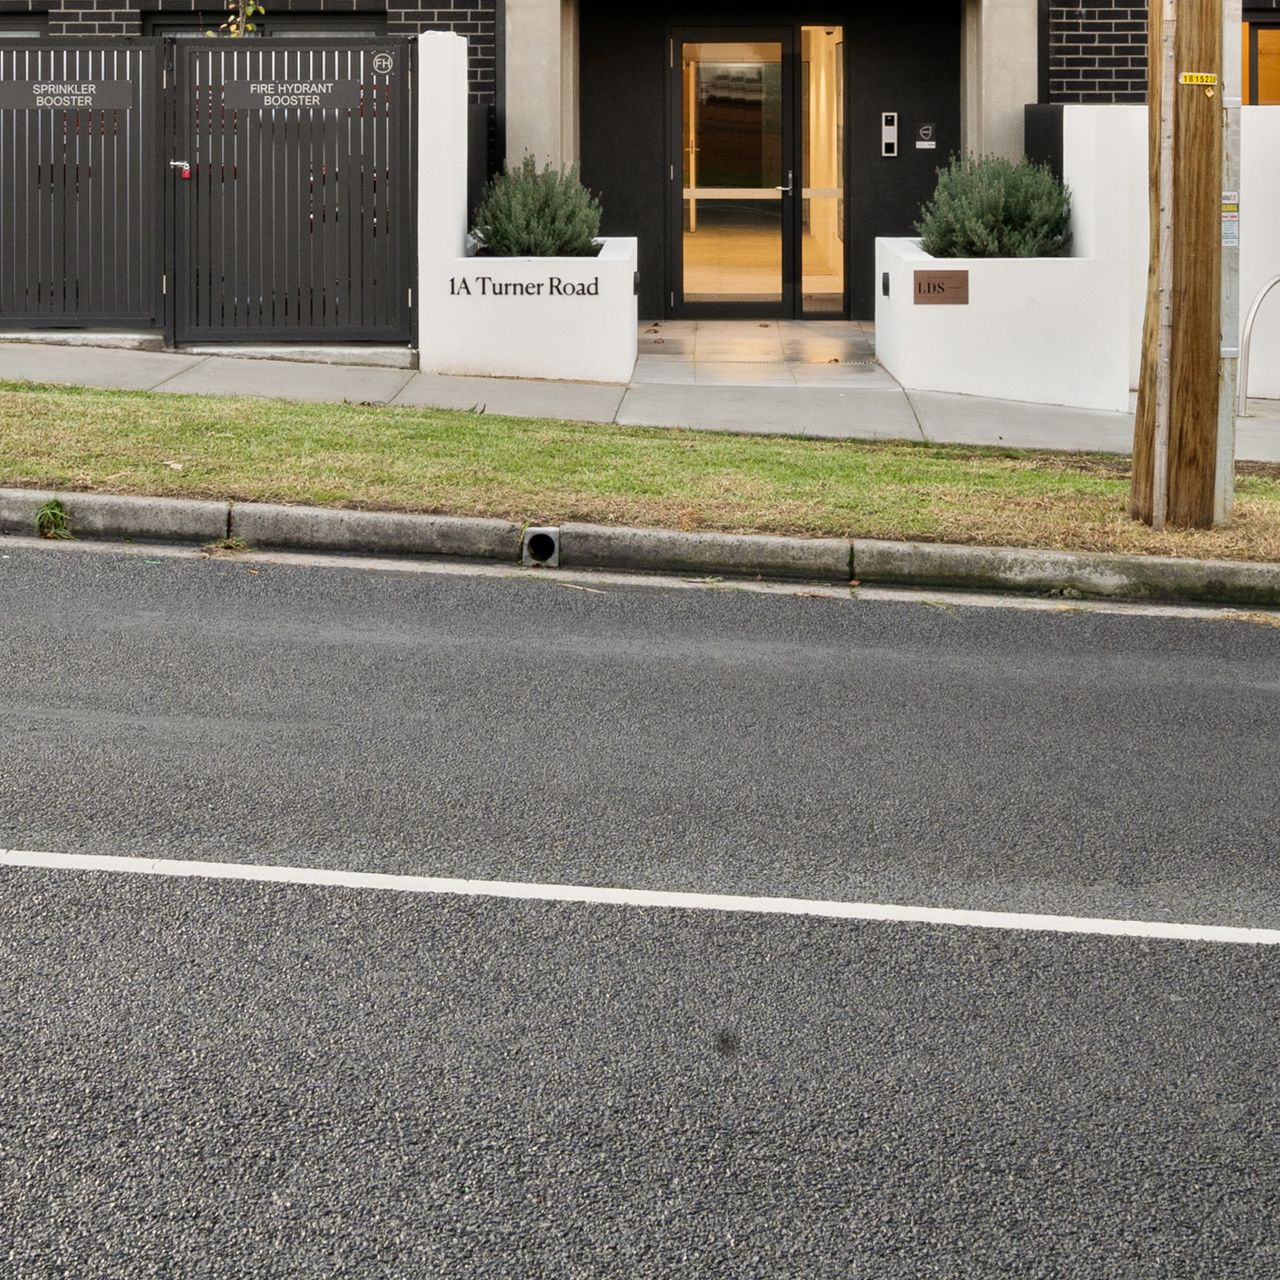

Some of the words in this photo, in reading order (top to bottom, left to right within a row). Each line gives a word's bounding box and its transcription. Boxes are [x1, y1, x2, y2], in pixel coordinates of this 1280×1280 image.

[375, 58, 391, 69] FH
[32, 84, 97, 95] SPRINKLER
[250, 83, 276, 94] FIRE
[278, 83, 334, 94] HYDRANT
[36, 96, 93, 107] BOOSTER
[263, 95, 321, 106] BOOSTER
[449, 277, 471, 296] 1A
[475, 276, 544, 296] Turner
[548, 276, 599, 296] Road
[918, 282, 945, 294] LDS
